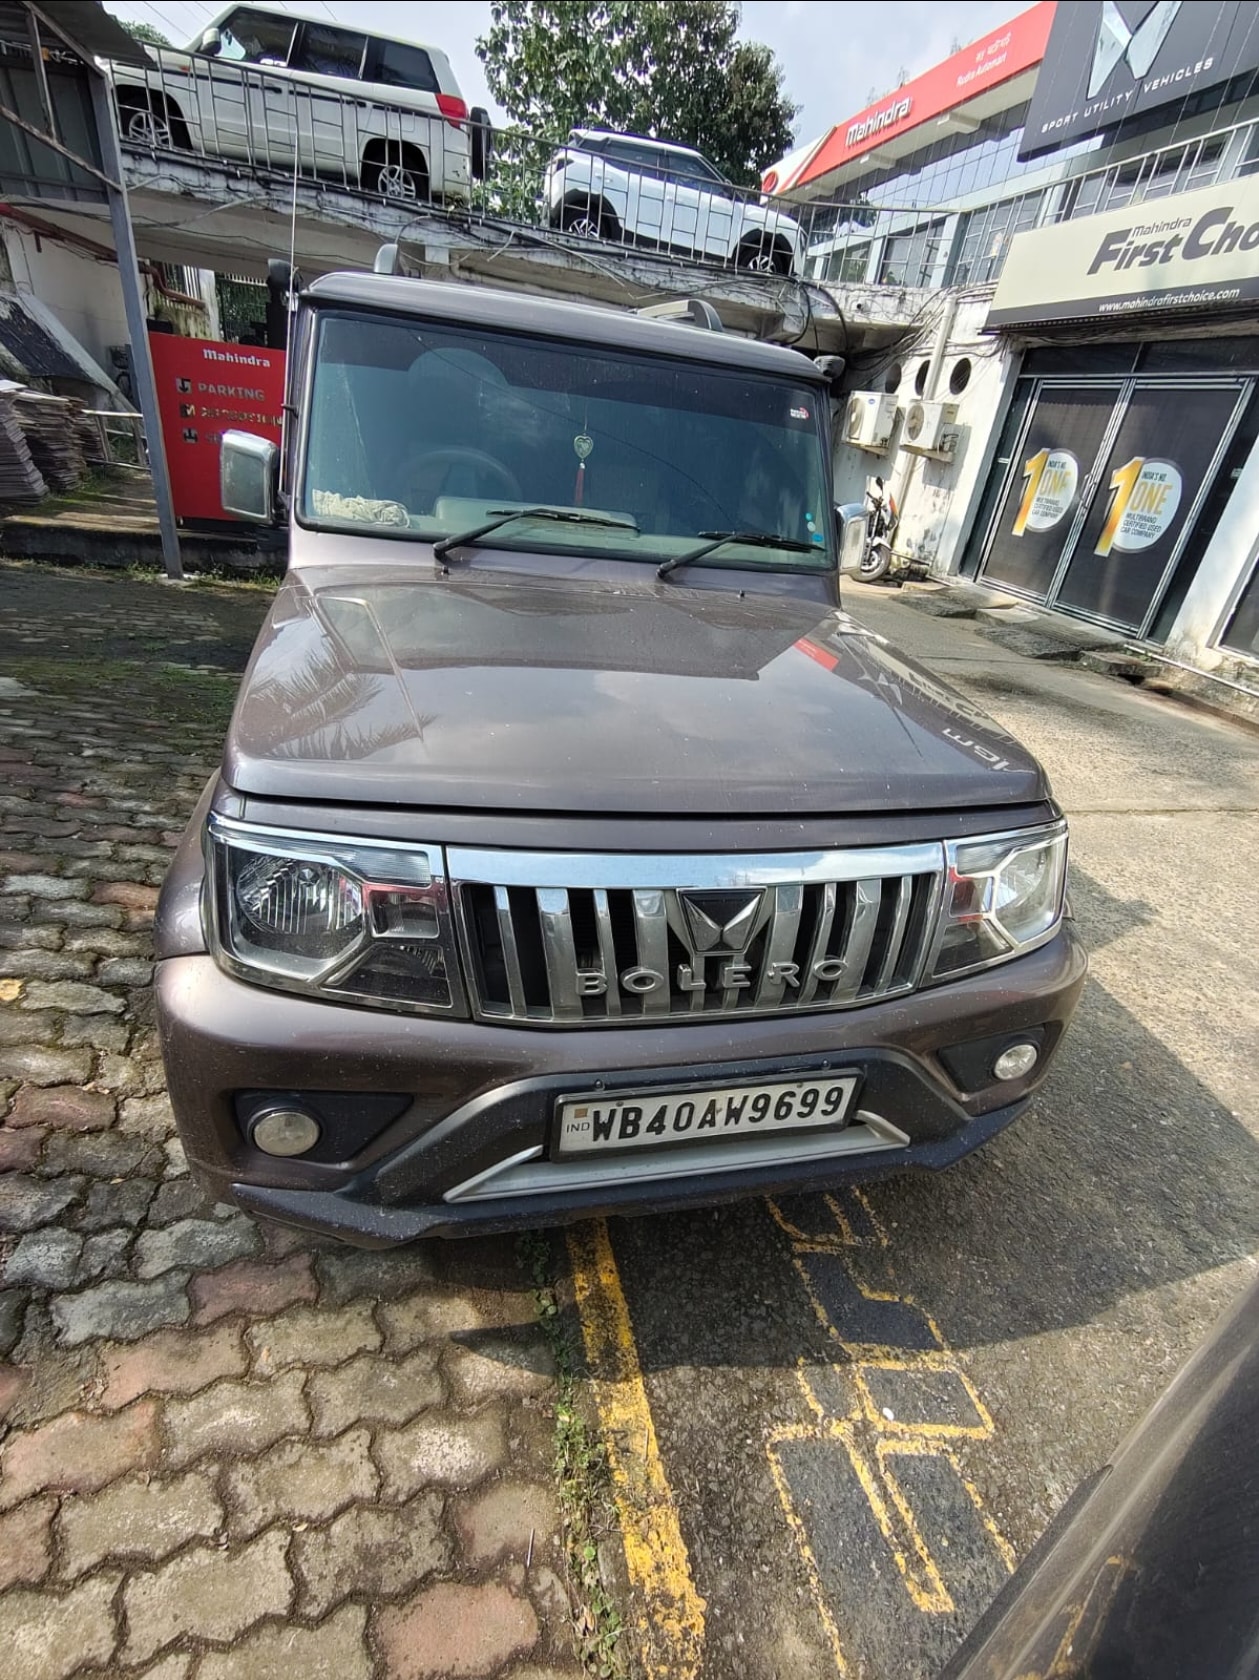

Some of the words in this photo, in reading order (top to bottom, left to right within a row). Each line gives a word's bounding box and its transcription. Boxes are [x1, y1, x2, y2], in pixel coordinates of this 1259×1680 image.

[1041, 112, 1079, 133] SPORT
[1084, 90, 1135, 118] UTILITY
[1144, 57, 1214, 94] VEHICLES
[845, 96, 912, 148] Mahindra
[1132, 217, 1193, 237] Mahindra
[1099, 288, 1240, 313] www.mahindrafirstchoice.com
[203, 348, 271, 367] Mahindra
[198, 383, 265, 401] PARKING
[1129, 481, 1173, 515] ONE
[575, 958, 849, 996] BOLERO
[566, 1122, 590, 1133] IND
[592, 1087, 844, 1142] WB40AW9699
